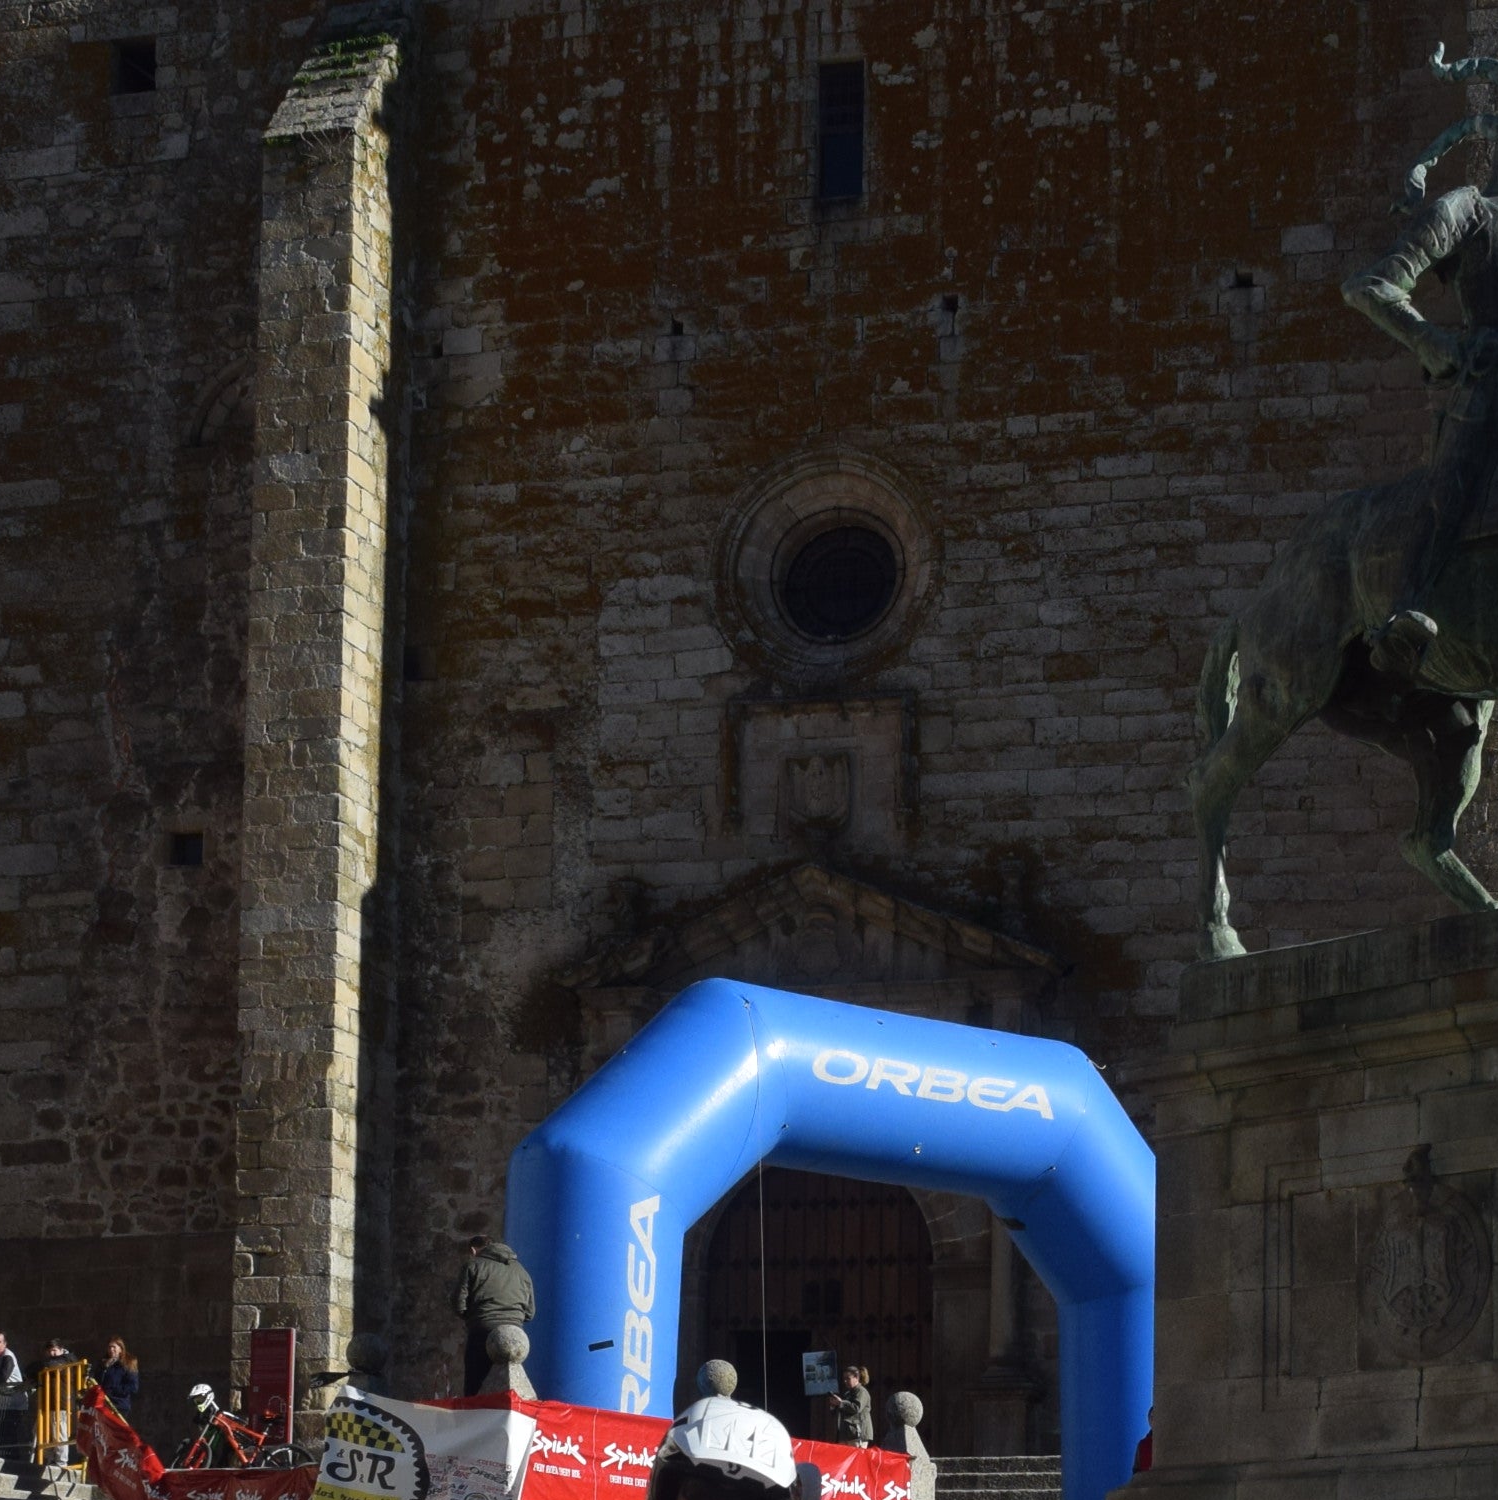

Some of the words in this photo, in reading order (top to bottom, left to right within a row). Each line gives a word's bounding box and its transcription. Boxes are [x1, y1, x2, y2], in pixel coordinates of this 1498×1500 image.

[811, 1048, 1054, 1120] ORBEA
[619, 1194, 661, 1416] RBEA
[529, 1429, 586, 1465] Spiuk
